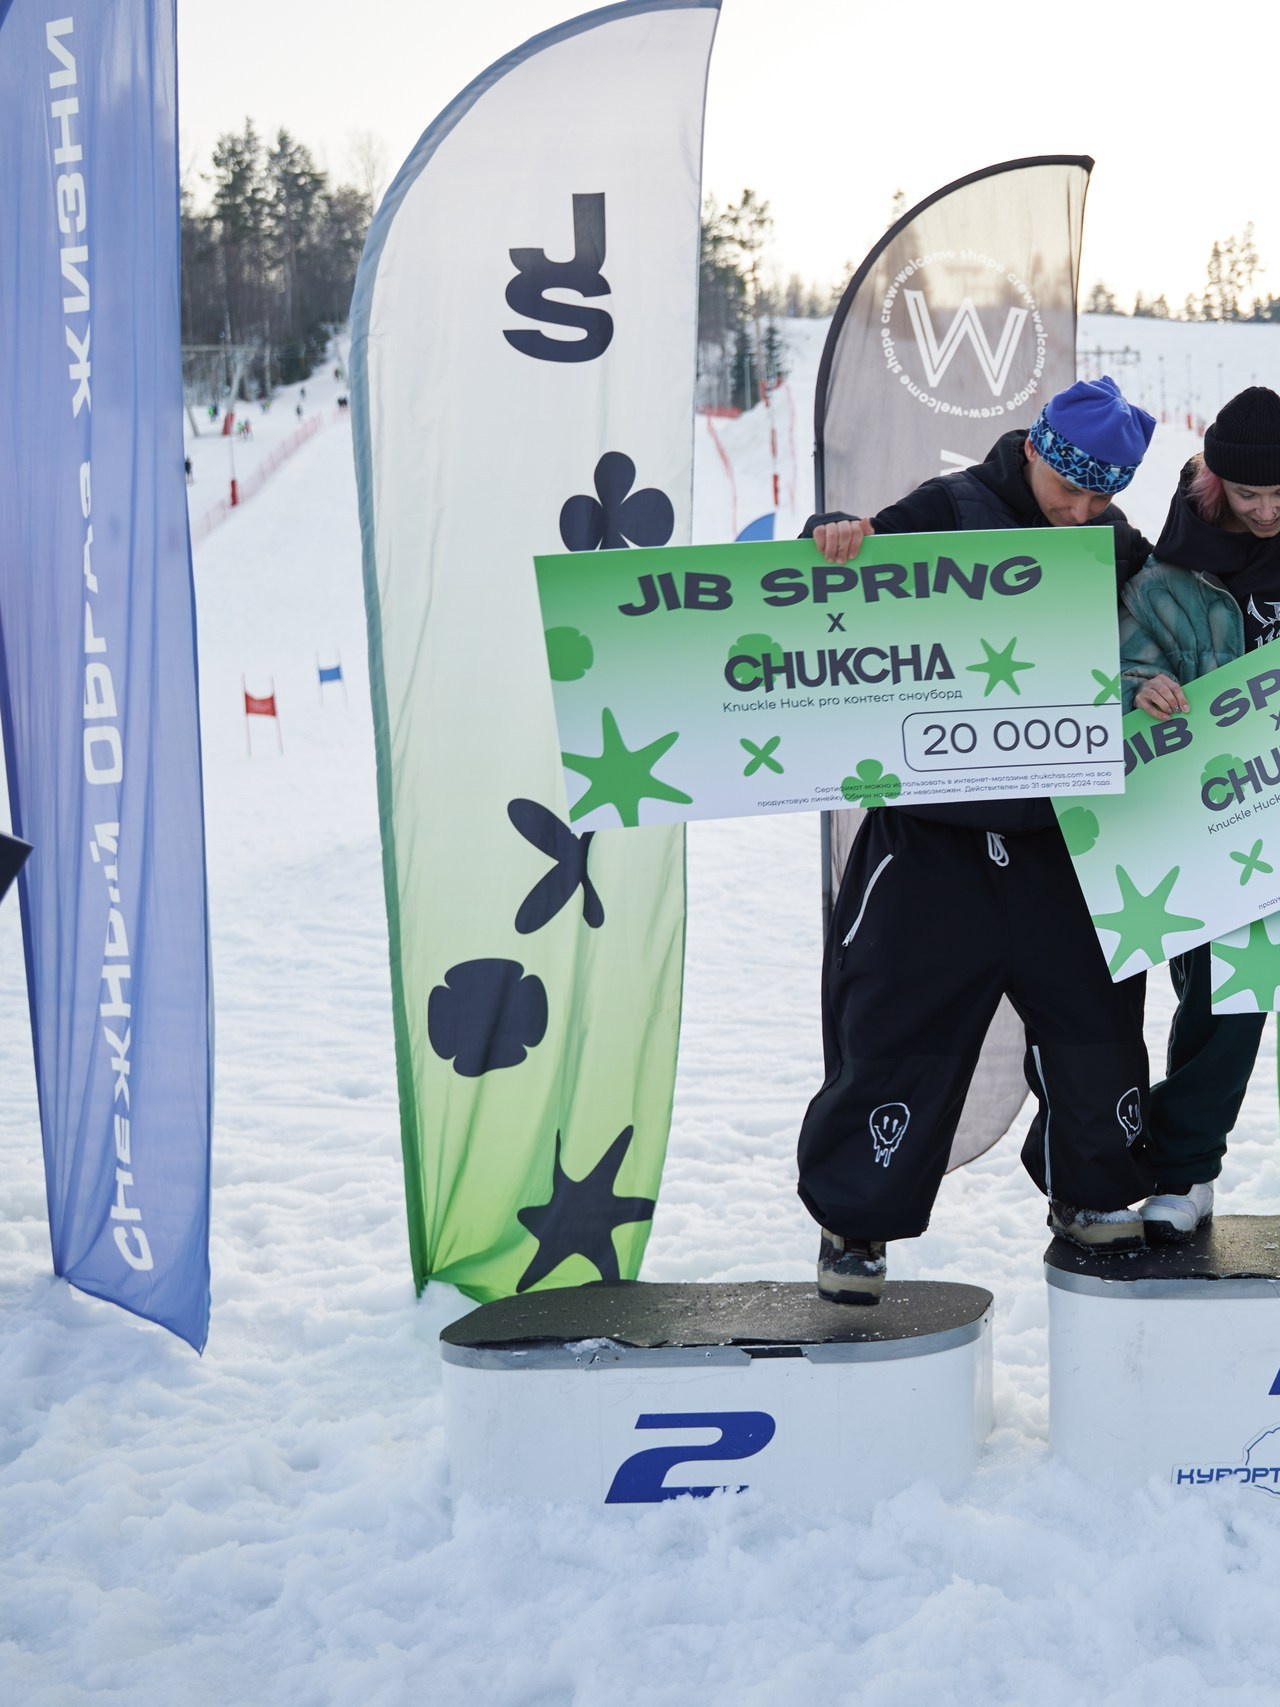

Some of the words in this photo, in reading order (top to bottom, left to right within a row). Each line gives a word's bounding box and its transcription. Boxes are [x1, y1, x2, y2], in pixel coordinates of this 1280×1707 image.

[46, 16, 92, 419] ЖИЗНИ
[903, 288, 1029, 397] W
[617, 571, 733, 617] JIB
[760, 555, 1043, 608] SPRING
[723, 643, 956, 694] CHUKCHA
[723, 700, 777, 713] Knuckle
[780, 697, 815, 709] Huck
[818, 697, 840, 709] pro
[844, 692, 895, 705] контест
[898, 689, 963, 703] сноуборд
[922, 723, 978, 757] 20
[757, 797, 809, 807] продуктовую
[884, 790, 912, 799] деньги
[964, 784, 1018, 793] Действителен
[1040, 780, 1070, 789] августа
[1071, 779, 1092, 787] 2024
[814, 784, 863, 794] Сертификат
[864, 782, 891, 791] можно
[893, 779, 945, 789] использовать
[953, 775, 1029, 784] интернет-магазине
[1207, 807, 1252, 835] Knuckle
[604, 1410, 777, 1504] 2
